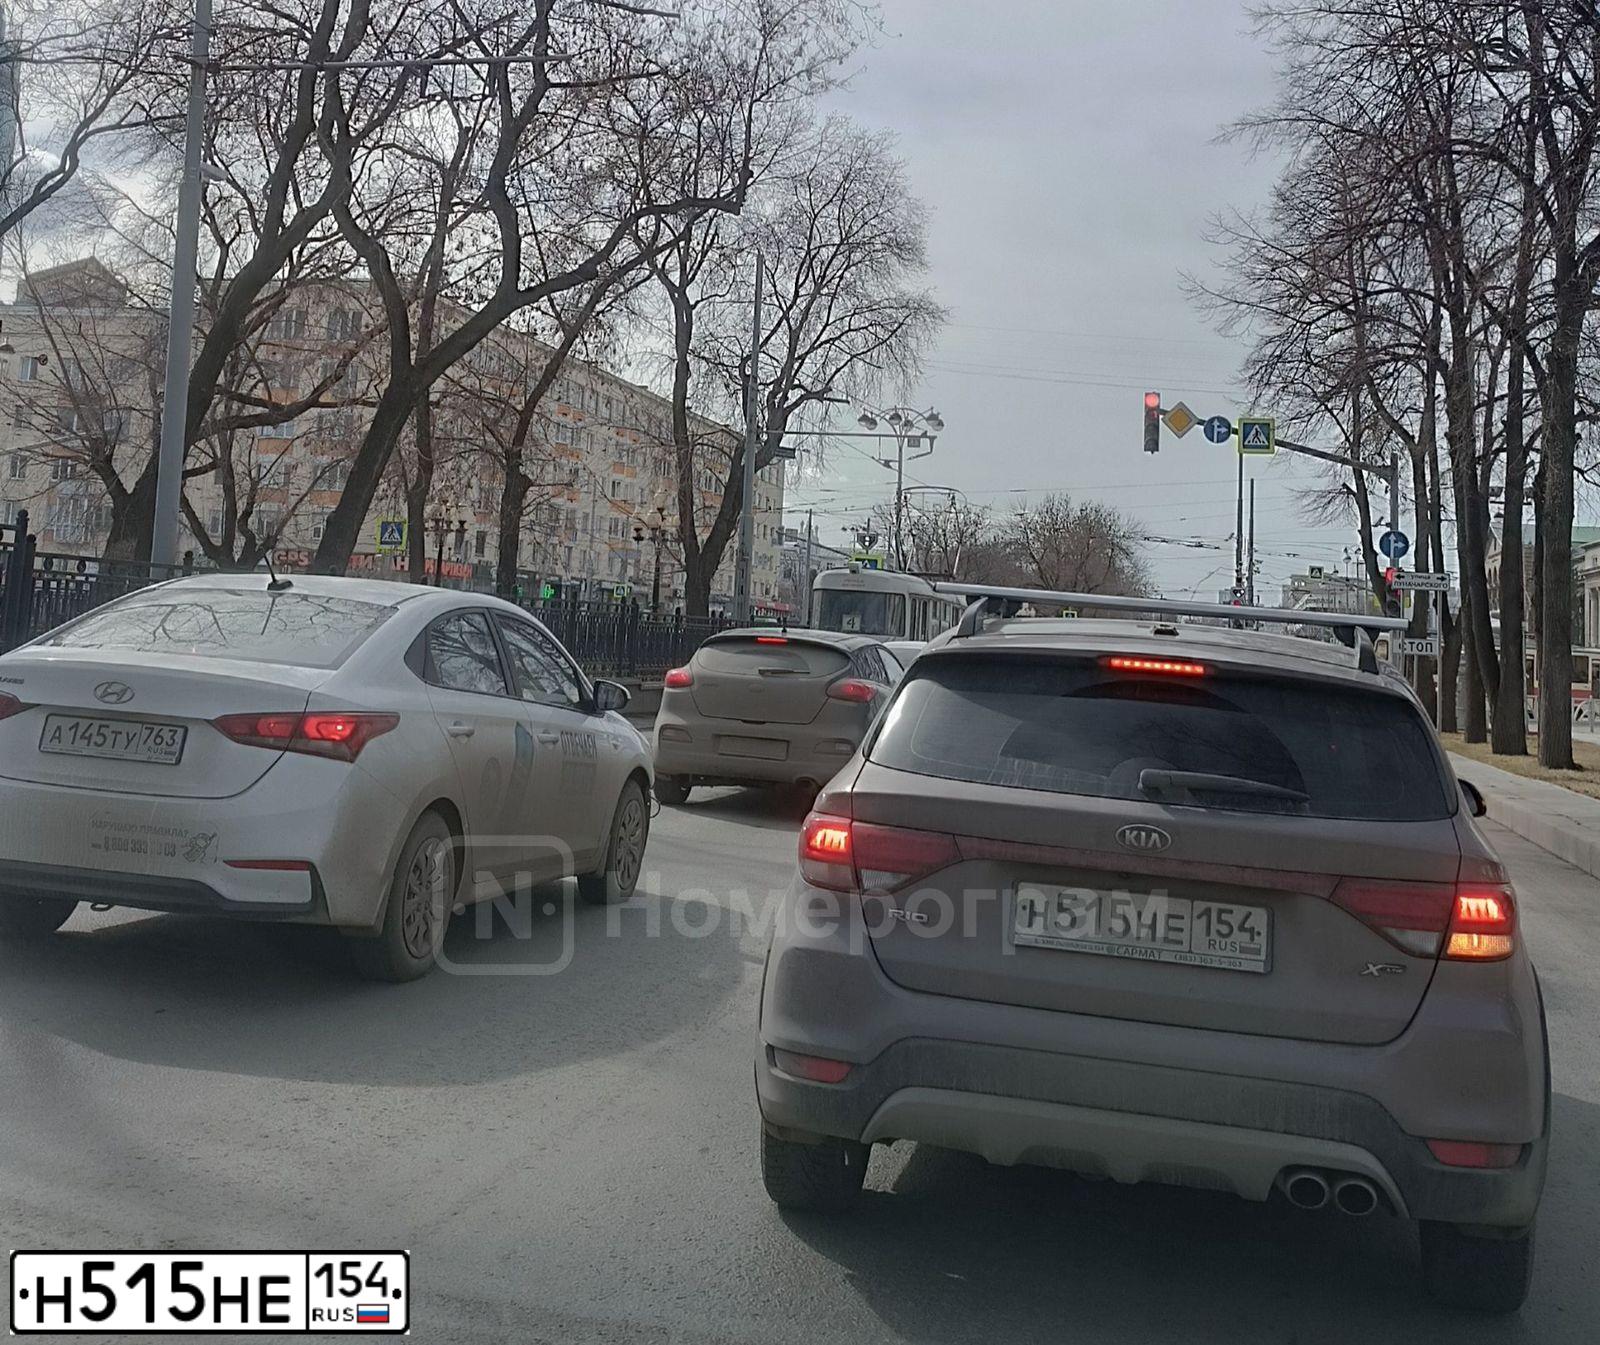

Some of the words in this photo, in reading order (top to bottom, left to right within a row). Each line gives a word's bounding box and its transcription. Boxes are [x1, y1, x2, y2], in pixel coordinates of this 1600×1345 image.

[846, 618, 856, 629] 4
[49, 721, 138, 750] А145ТУ
[142, 726, 179, 748] 763
[1125, 829, 1162, 849] KIA
[888, 907, 929, 923] RIO
[1196, 905, 1257, 943] 154
[1208, 939, 1239, 953] RUS
